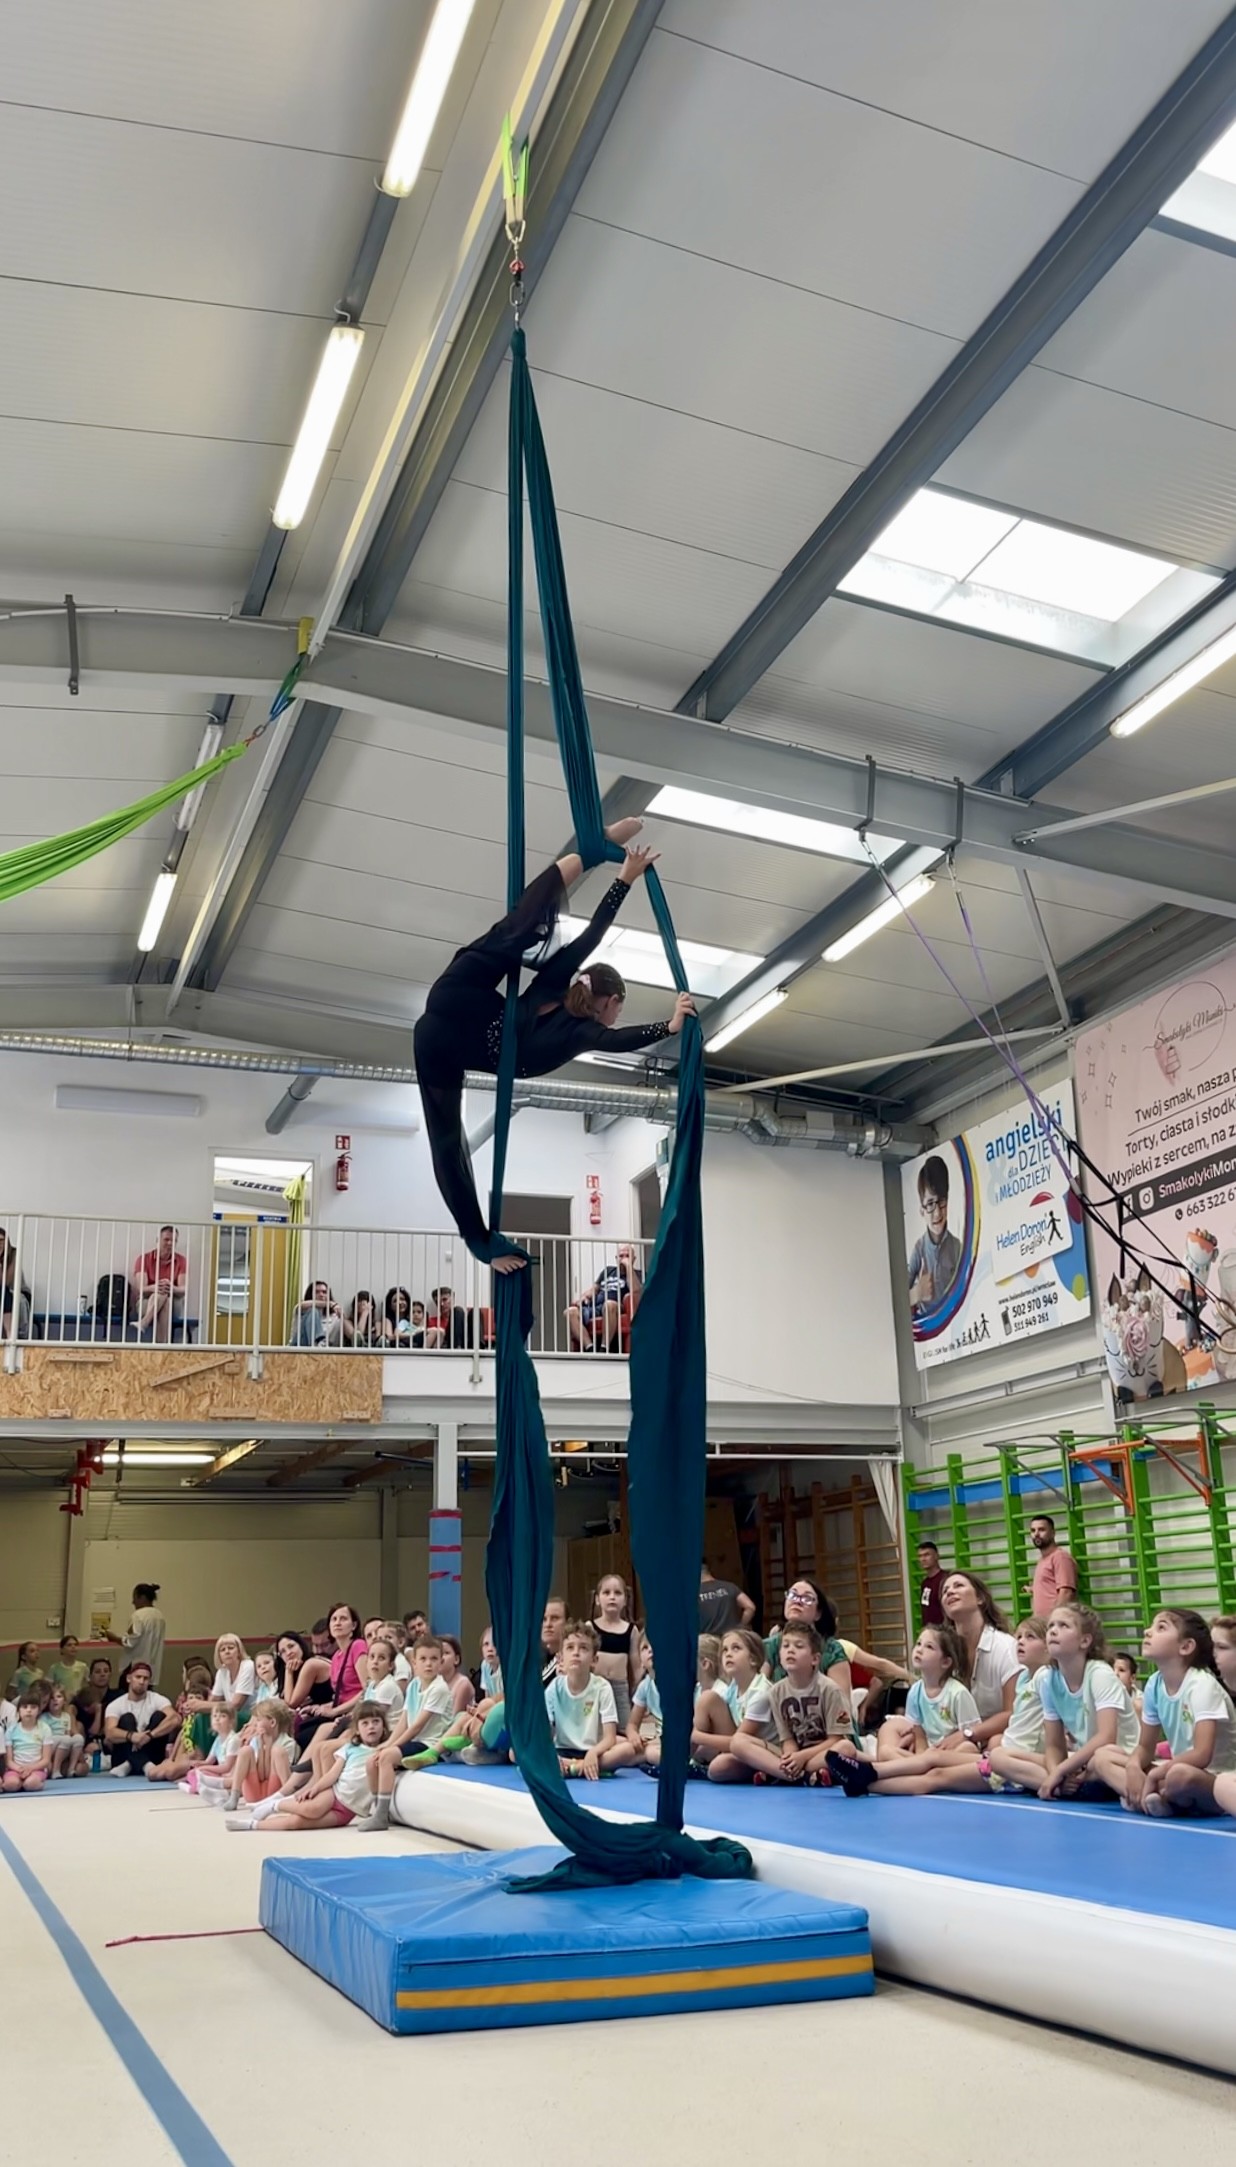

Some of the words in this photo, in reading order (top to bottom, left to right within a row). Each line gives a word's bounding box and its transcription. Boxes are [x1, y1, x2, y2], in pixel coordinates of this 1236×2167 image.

[1135, 1100, 1162, 1123] Twój
[1163, 1087, 1196, 1111] smak,
[1197, 1071, 1230, 1096] nasza
[1125, 1134, 1159, 1157] Torty,
[1160, 1117, 1194, 1142] ciasta
[1195, 1111, 1200, 1126] i
[1107, 1156, 1153, 1187] Wypieki
[1154, 1156, 1162, 1169] z
[1163, 1137, 1210, 1165] sercem,
[1211, 1128, 1227, 1145] na
[999, 1163, 1052, 1202] MŁODZIEŻY
[1186, 1199, 1205, 1217] 663
[1207, 1192, 1227, 1210] 322
[1228, 1187, 1236, 1201] 6
[996, 1230, 1020, 1251] Helen
[1020, 1218, 1048, 1241] Doron
[1020, 1233, 1047, 1256] English
[1012, 1303, 1026, 1318] 502
[1027, 1297, 1042, 1314] 970
